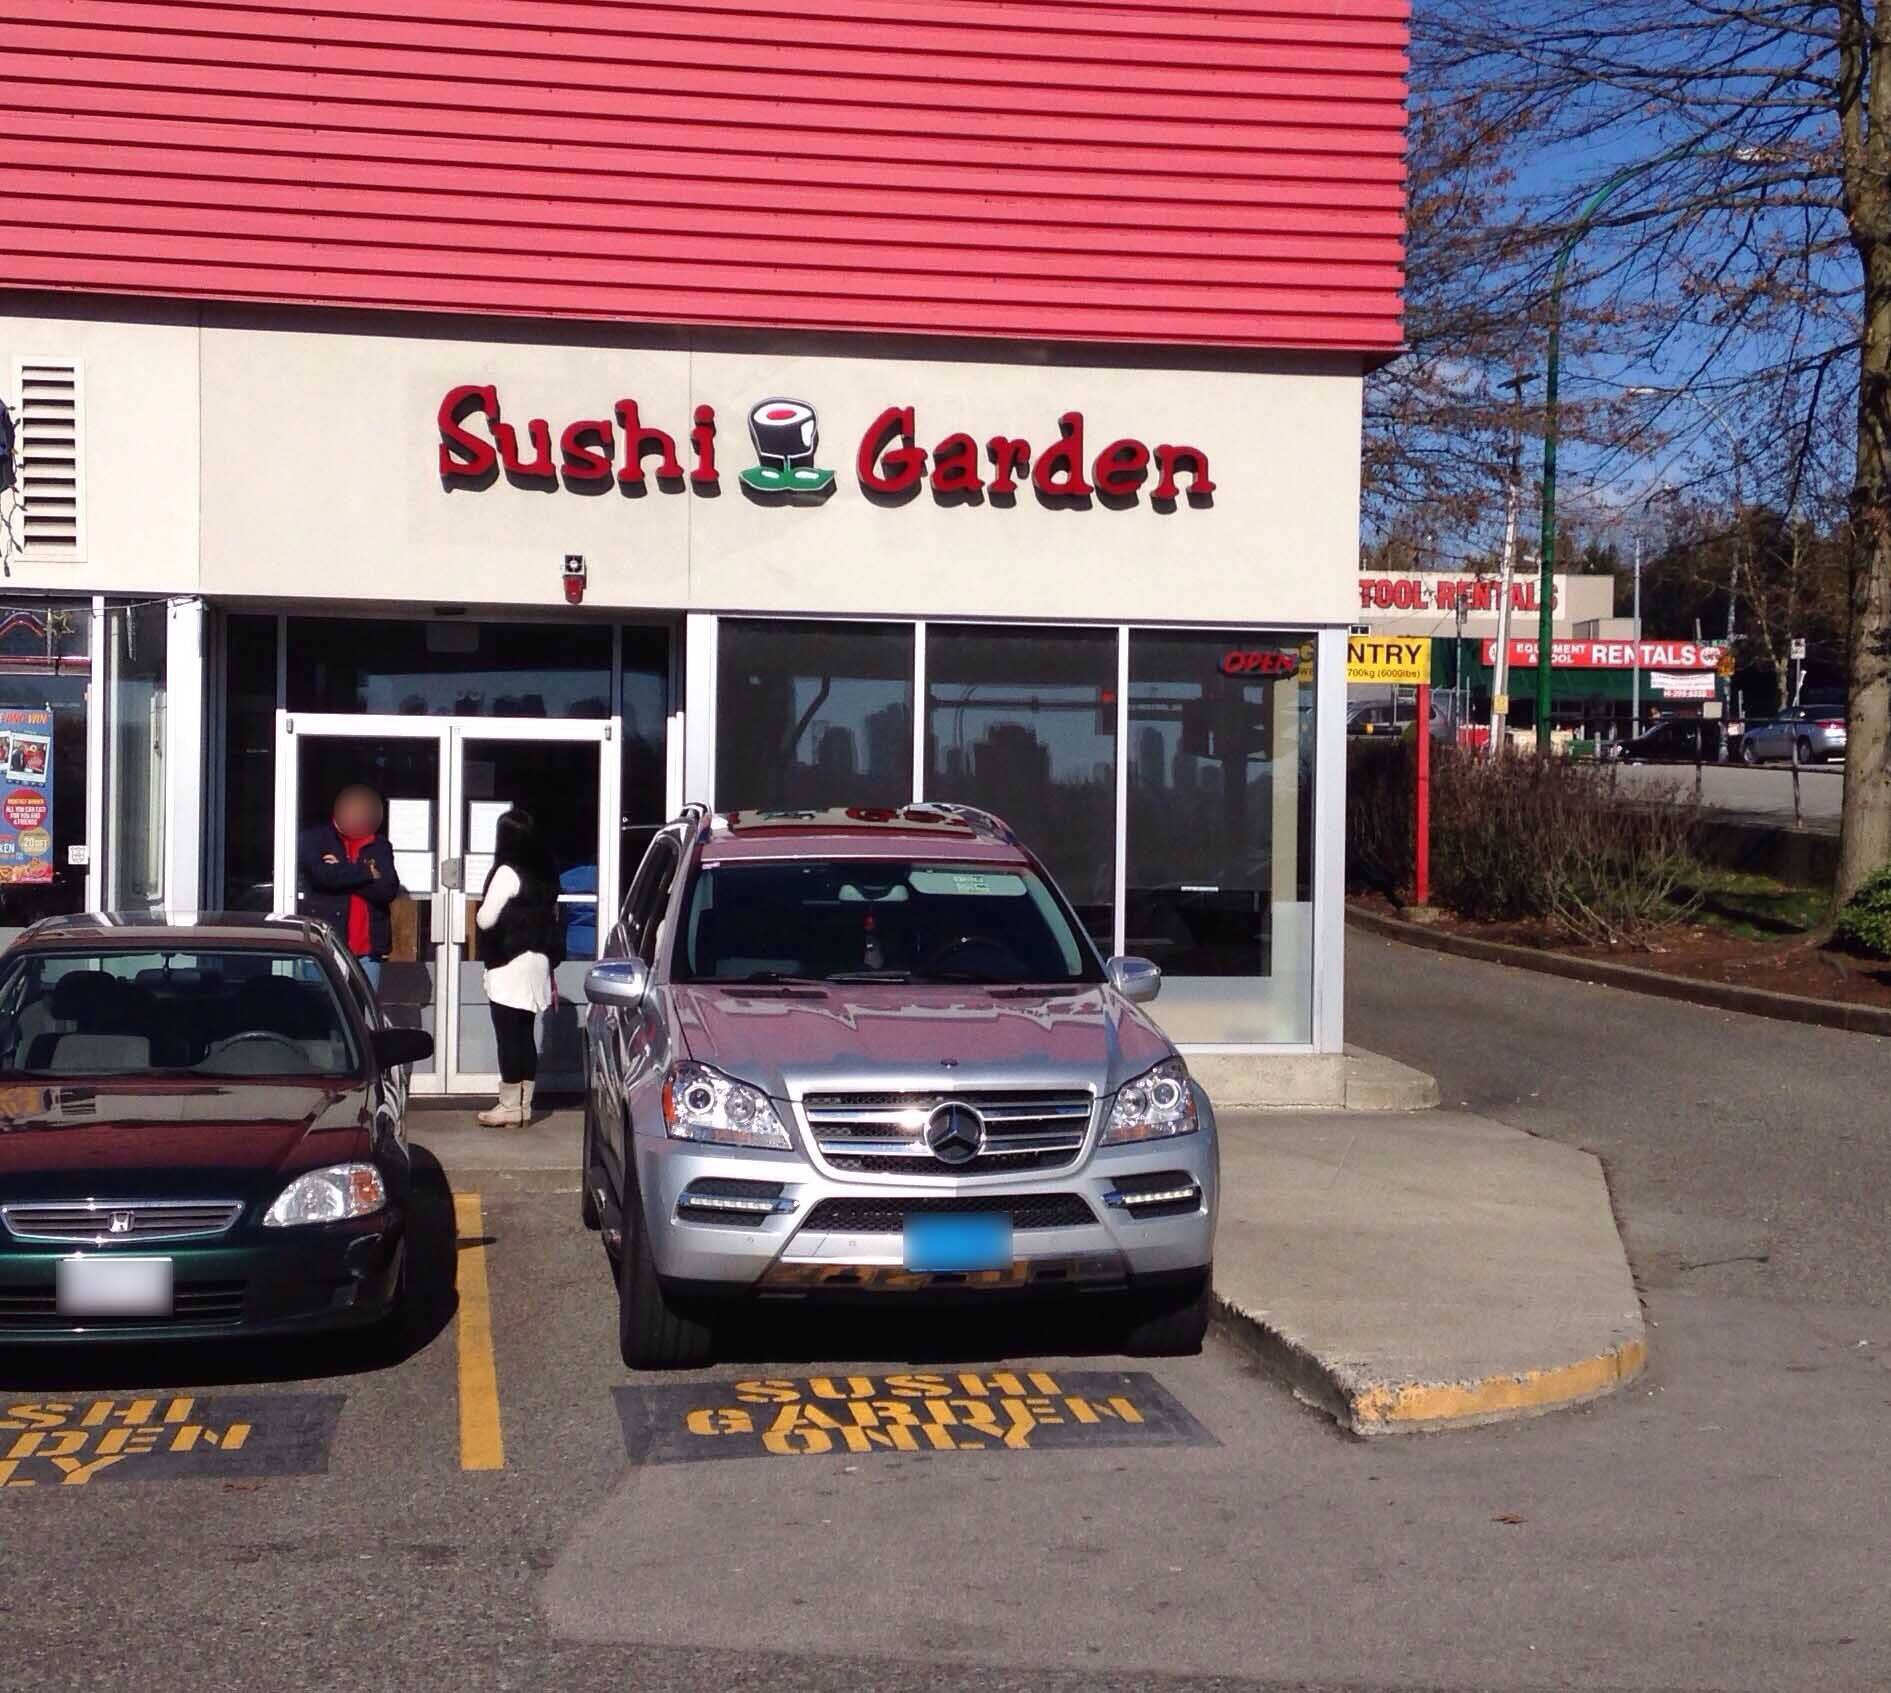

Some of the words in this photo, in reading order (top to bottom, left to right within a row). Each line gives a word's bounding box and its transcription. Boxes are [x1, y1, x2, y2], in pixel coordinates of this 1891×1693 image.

[438, 384, 721, 498] Sushi
[856, 405, 1216, 514] Garden
[1359, 579, 1428, 609] TOOL
[1223, 650, 1297, 672] OPEN
[1591, 644, 1696, 666] RENTALS
[735, 1372, 1062, 1403] SUSHI
[686, 1398, 1144, 1435] GARDEN
[762, 1424, 1031, 1455] ONLY
